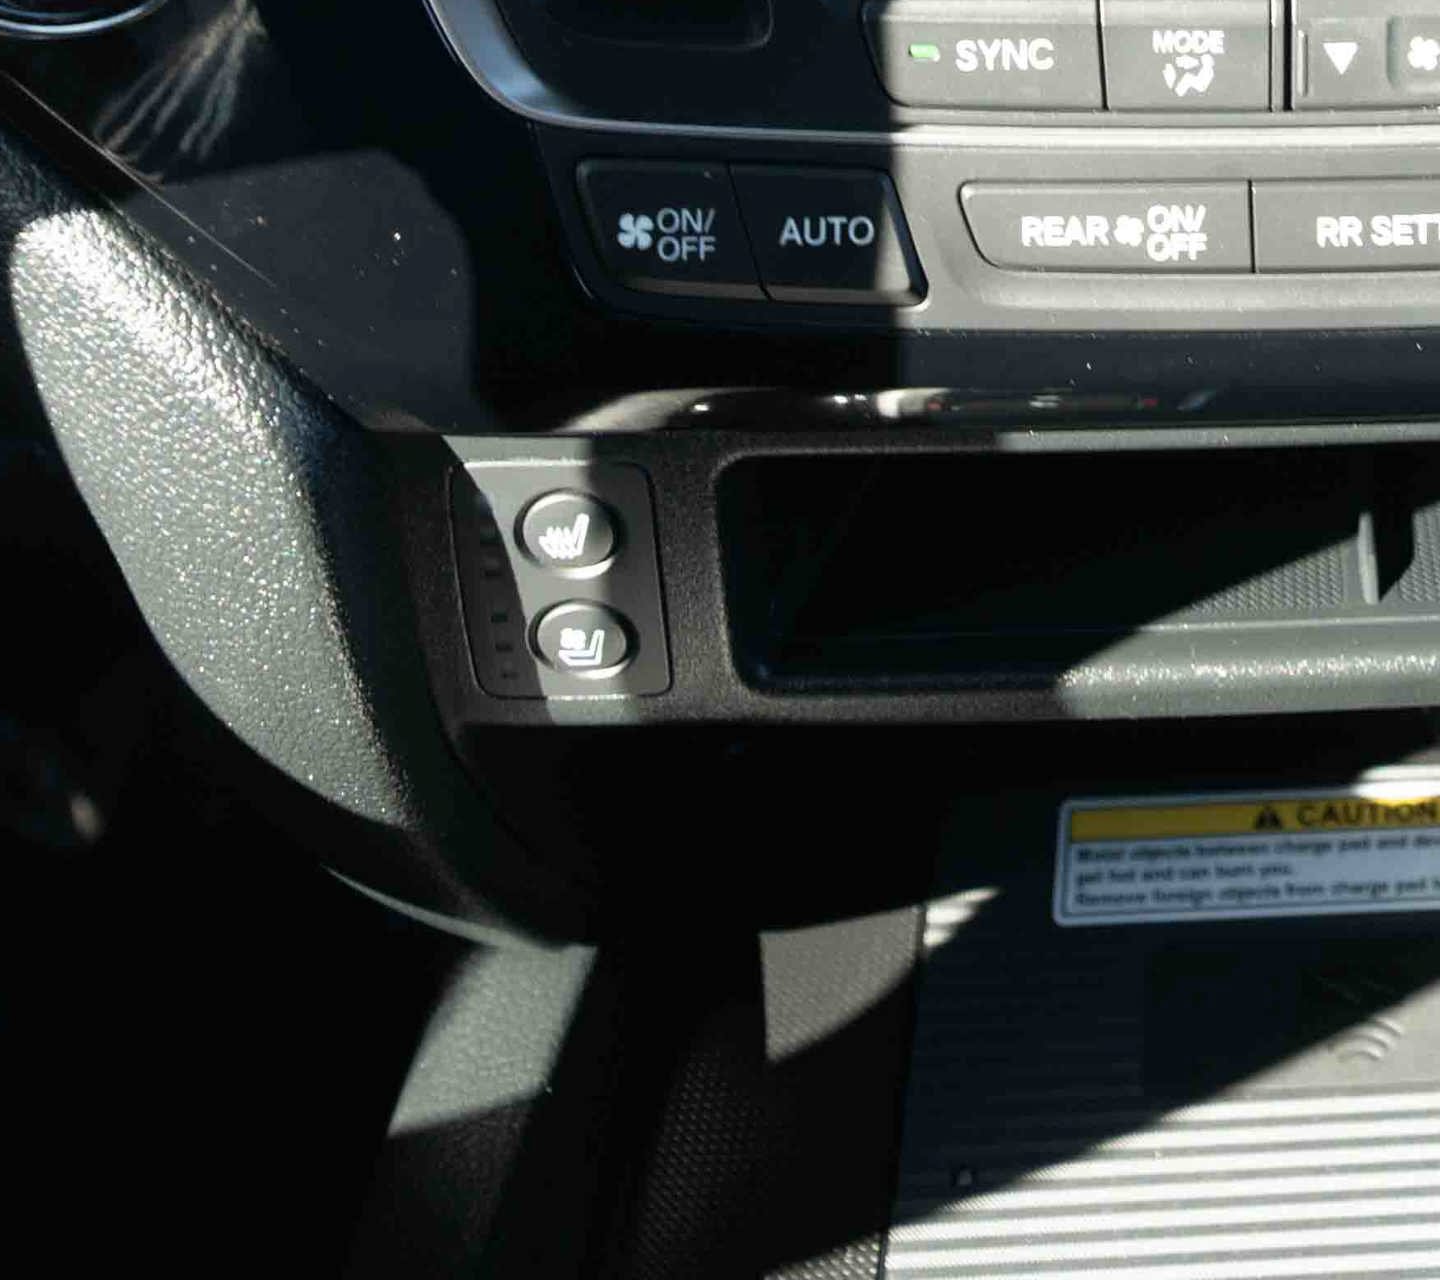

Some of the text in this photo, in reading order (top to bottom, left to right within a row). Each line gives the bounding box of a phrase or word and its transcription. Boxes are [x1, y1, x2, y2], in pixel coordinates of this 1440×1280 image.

[956, 39, 1054, 72] SYNC
[1153, 30, 1224, 54] MODE
[657, 208, 715, 235] ON/
[780, 217, 874, 245] AUTO
[1021, 215, 1108, 246] REAR
[1146, 203, 1206, 231] ON/
[1316, 216, 1364, 248] RR
[657, 236, 715, 262] OFF
[1146, 233, 1206, 261] OFF
[1297, 801, 1438, 827] CAUTION
